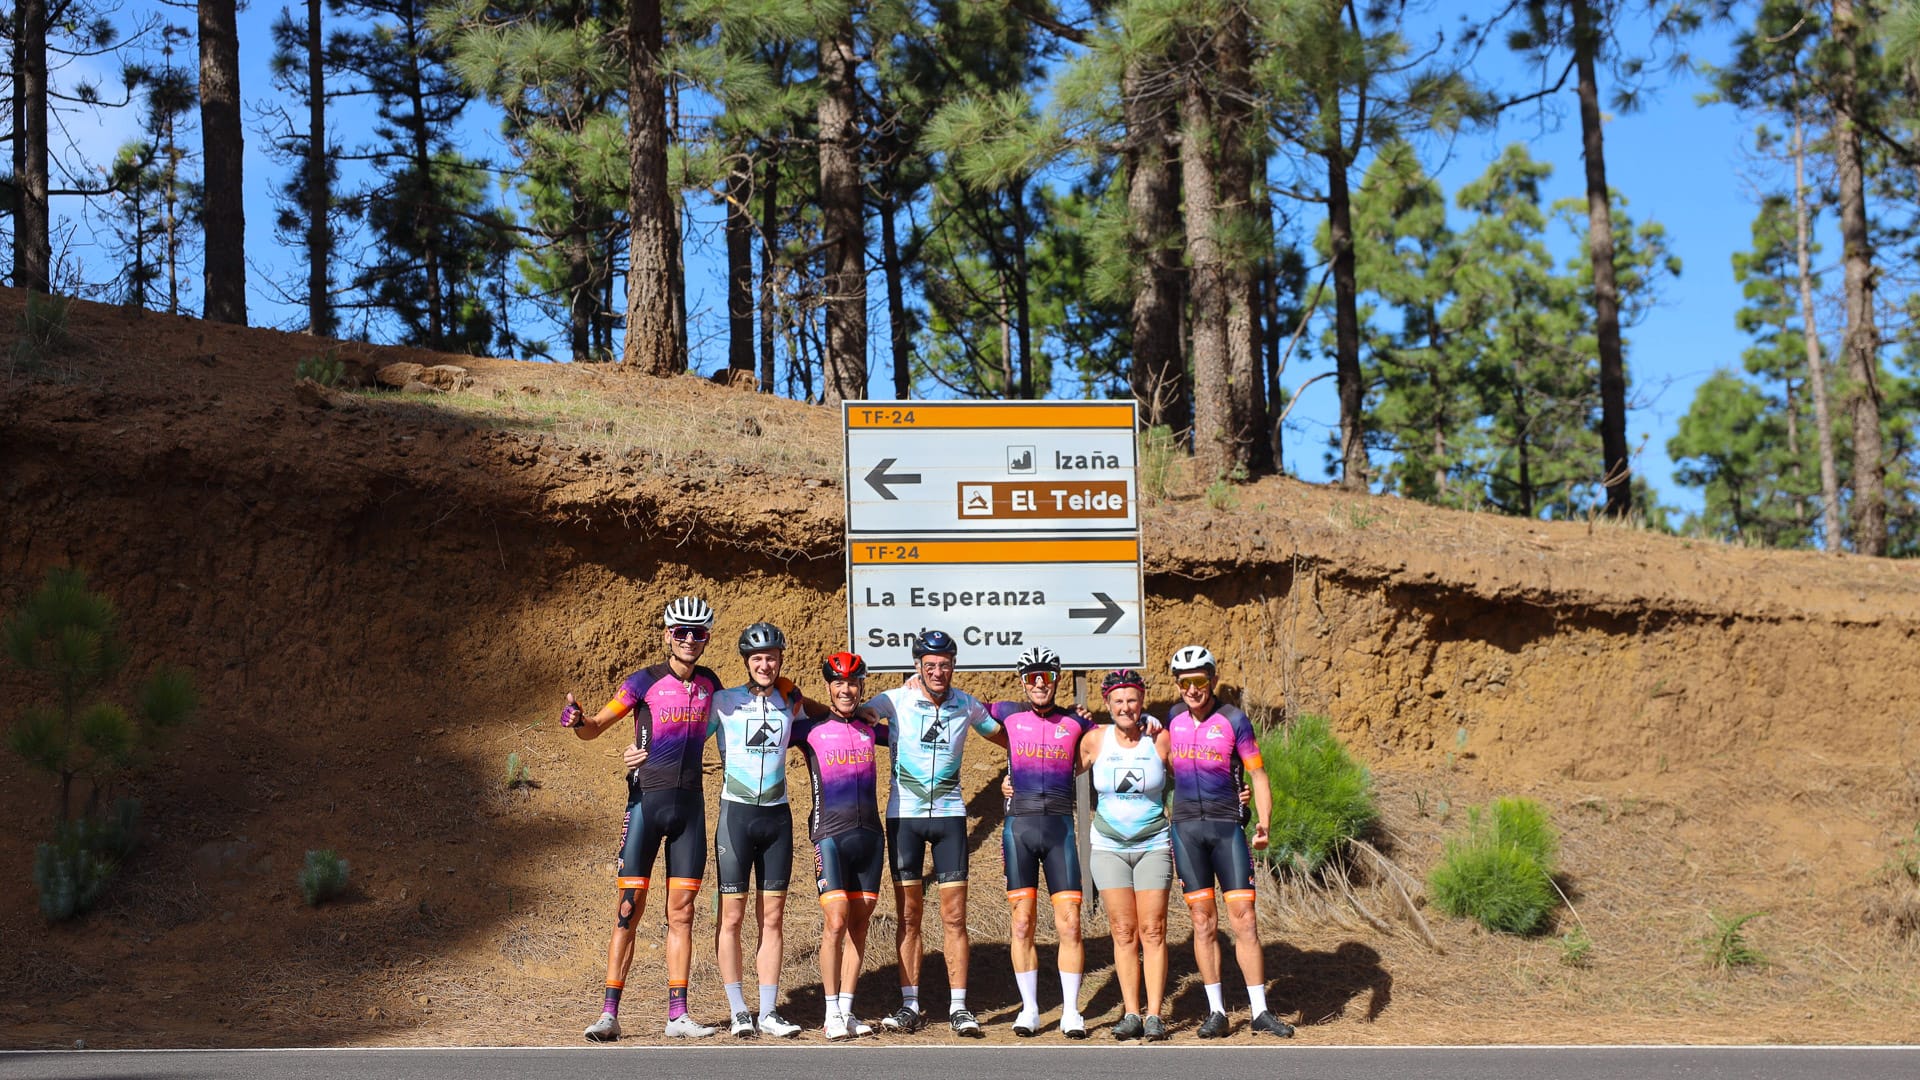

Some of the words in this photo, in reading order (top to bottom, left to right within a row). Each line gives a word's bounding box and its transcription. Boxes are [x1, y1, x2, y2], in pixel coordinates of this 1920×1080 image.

[861, 410, 916, 425] TF-24
[1055, 450, 1120, 470] Izaña
[1011, 489, 1037, 512] El
[1050, 489, 1123, 511] Teide
[865, 545, 920, 560] TF-24
[865, 587, 896, 608] La
[910, 587, 1046, 612] Esperanza
[868, 626, 929, 648] San
[963, 625, 1024, 647] Cruz
